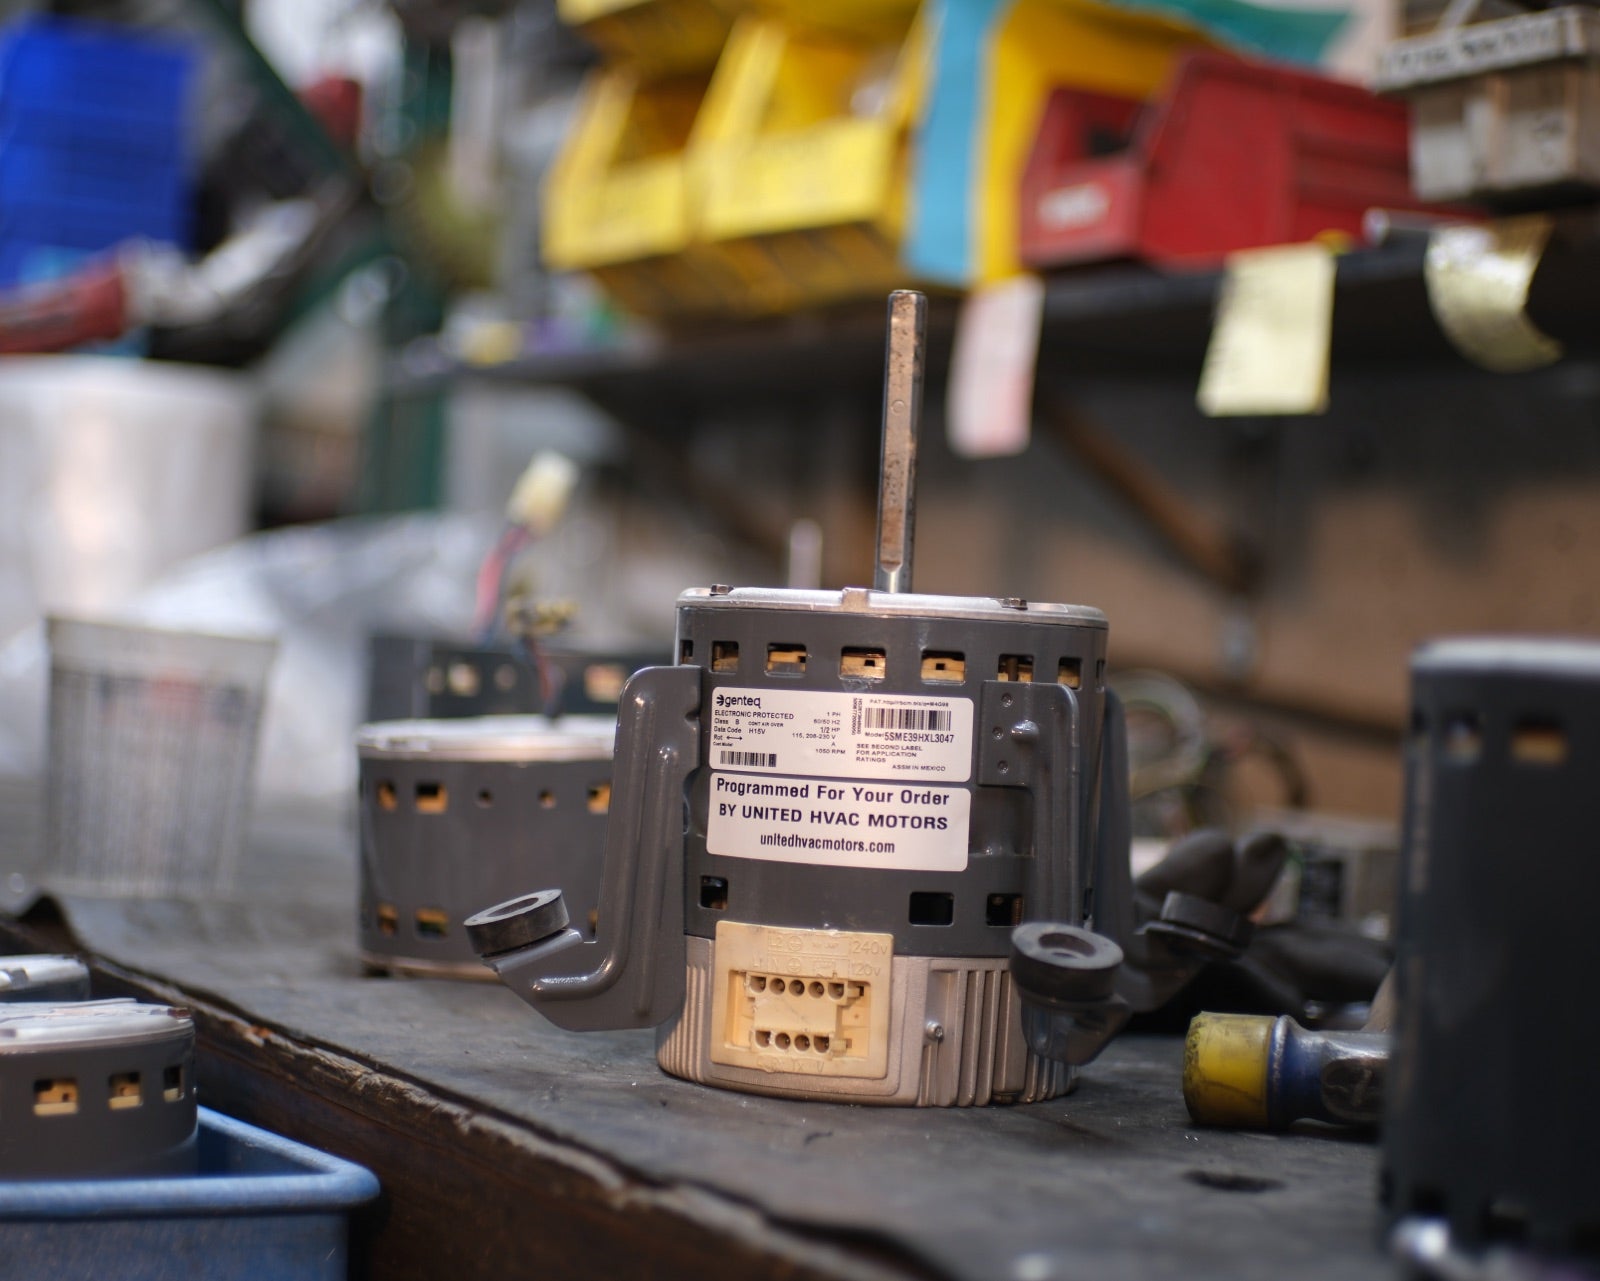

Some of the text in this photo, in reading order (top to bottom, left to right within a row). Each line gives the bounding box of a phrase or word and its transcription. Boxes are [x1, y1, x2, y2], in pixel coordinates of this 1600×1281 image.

[725, 695, 761, 708] genteq
[715, 710, 794, 720] ELECTRONIC PROTECTED
[727, 726, 742, 734] Code
[885, 732, 954, 743] 5SME39HXL3047
[716, 778, 950, 805] Programmed For Your Order
[719, 803, 948, 830] BY UNITED HVAC MOTORS
[760, 833, 895, 853] unitedhvacmotors.com
